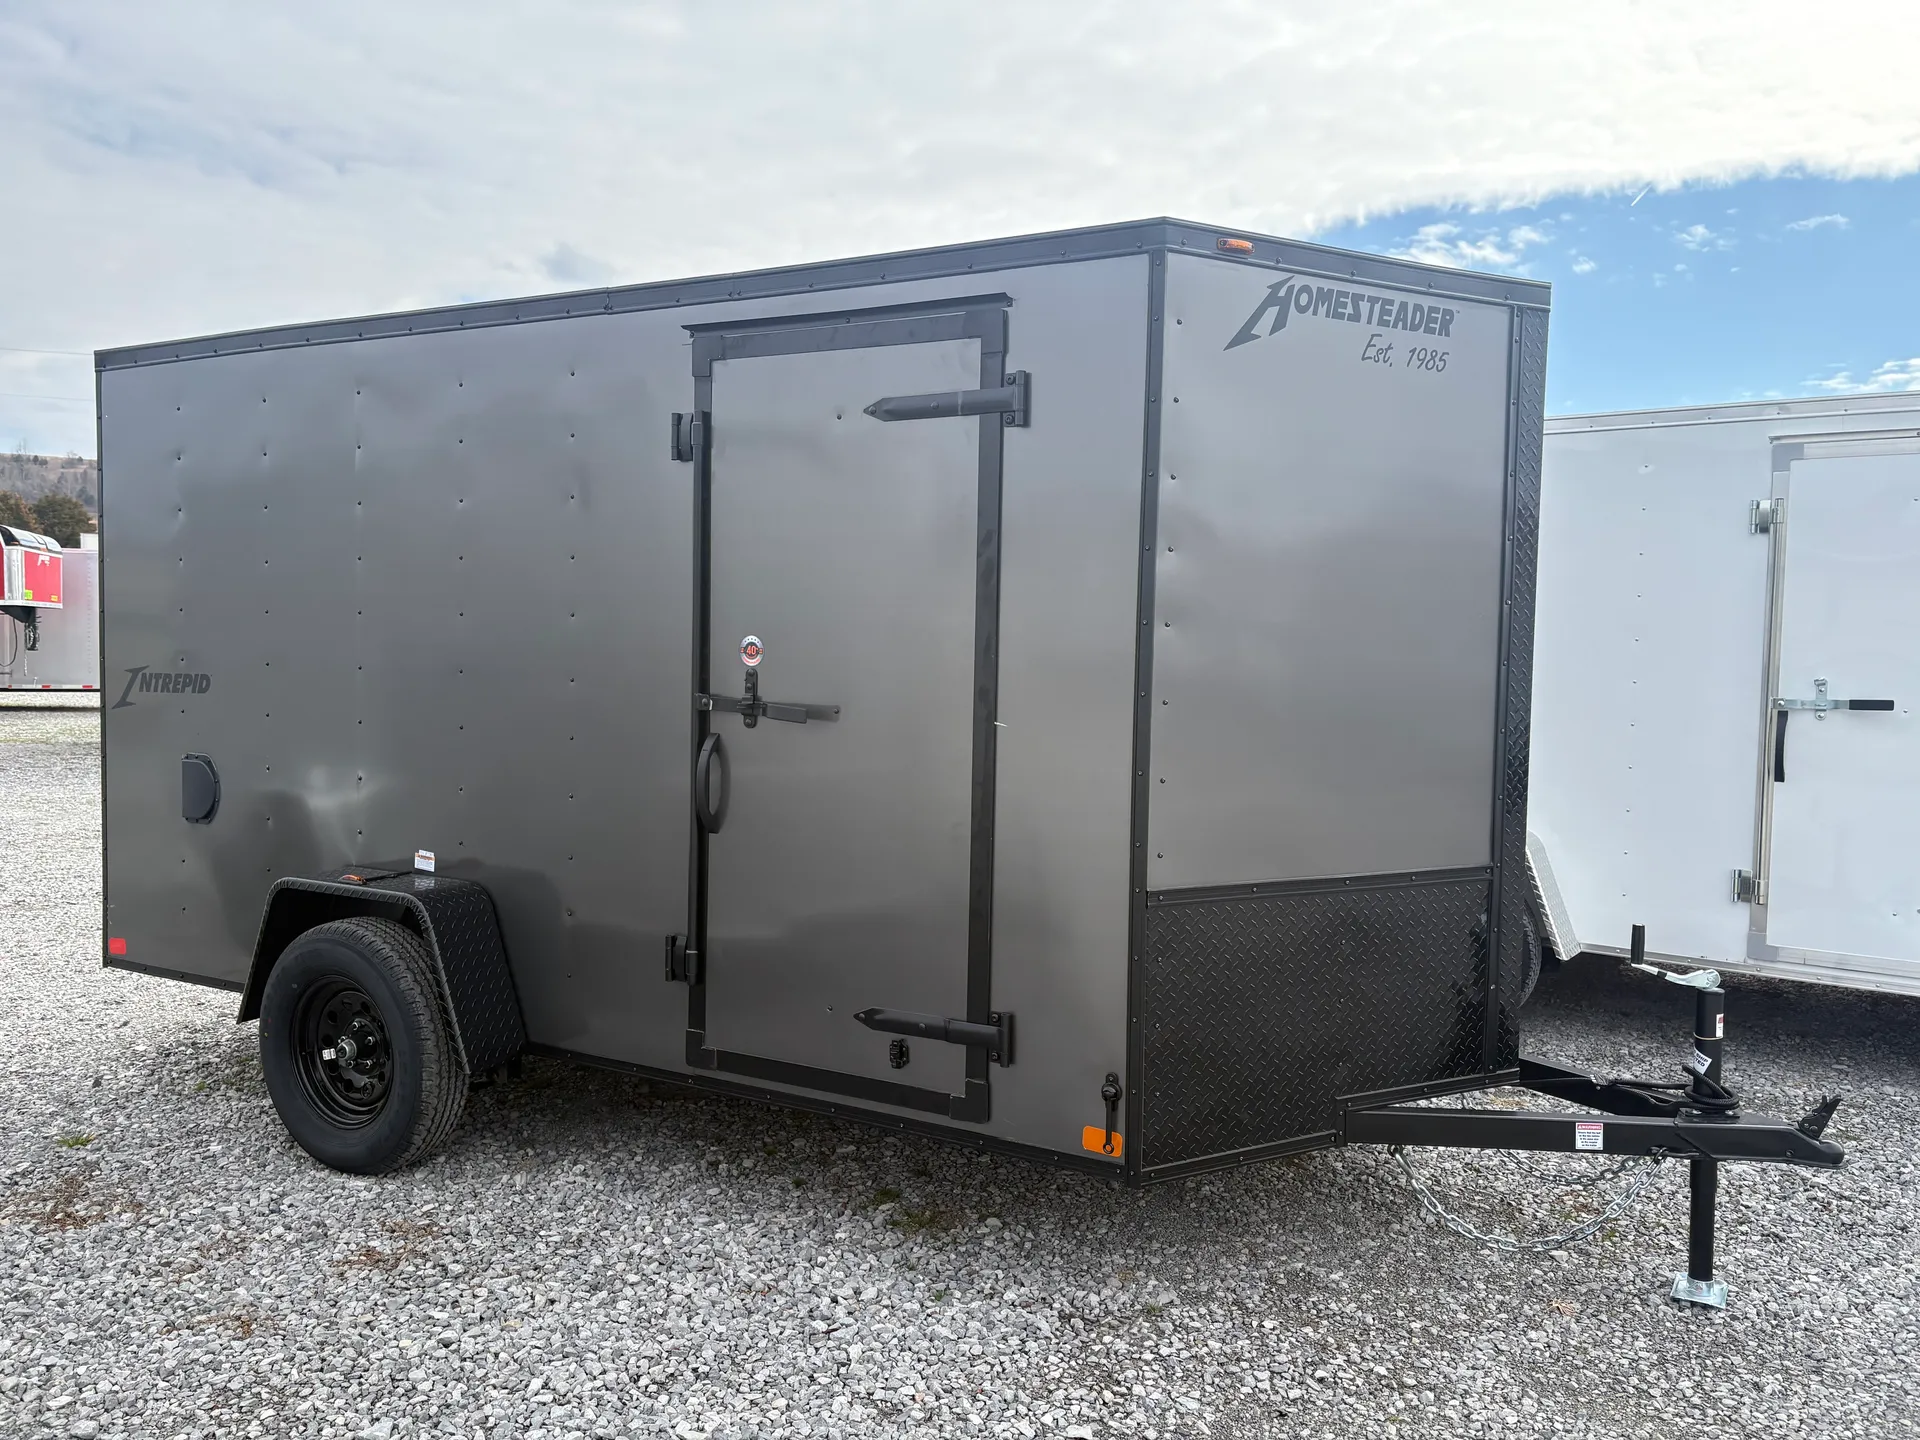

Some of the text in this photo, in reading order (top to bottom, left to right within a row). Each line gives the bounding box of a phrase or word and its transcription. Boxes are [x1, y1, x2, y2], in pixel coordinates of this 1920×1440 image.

[1223, 275, 1455, 351] HOMESTEADER
[1361, 333, 1450, 372] Est. 1985
[112, 665, 211, 709] INTREPID
